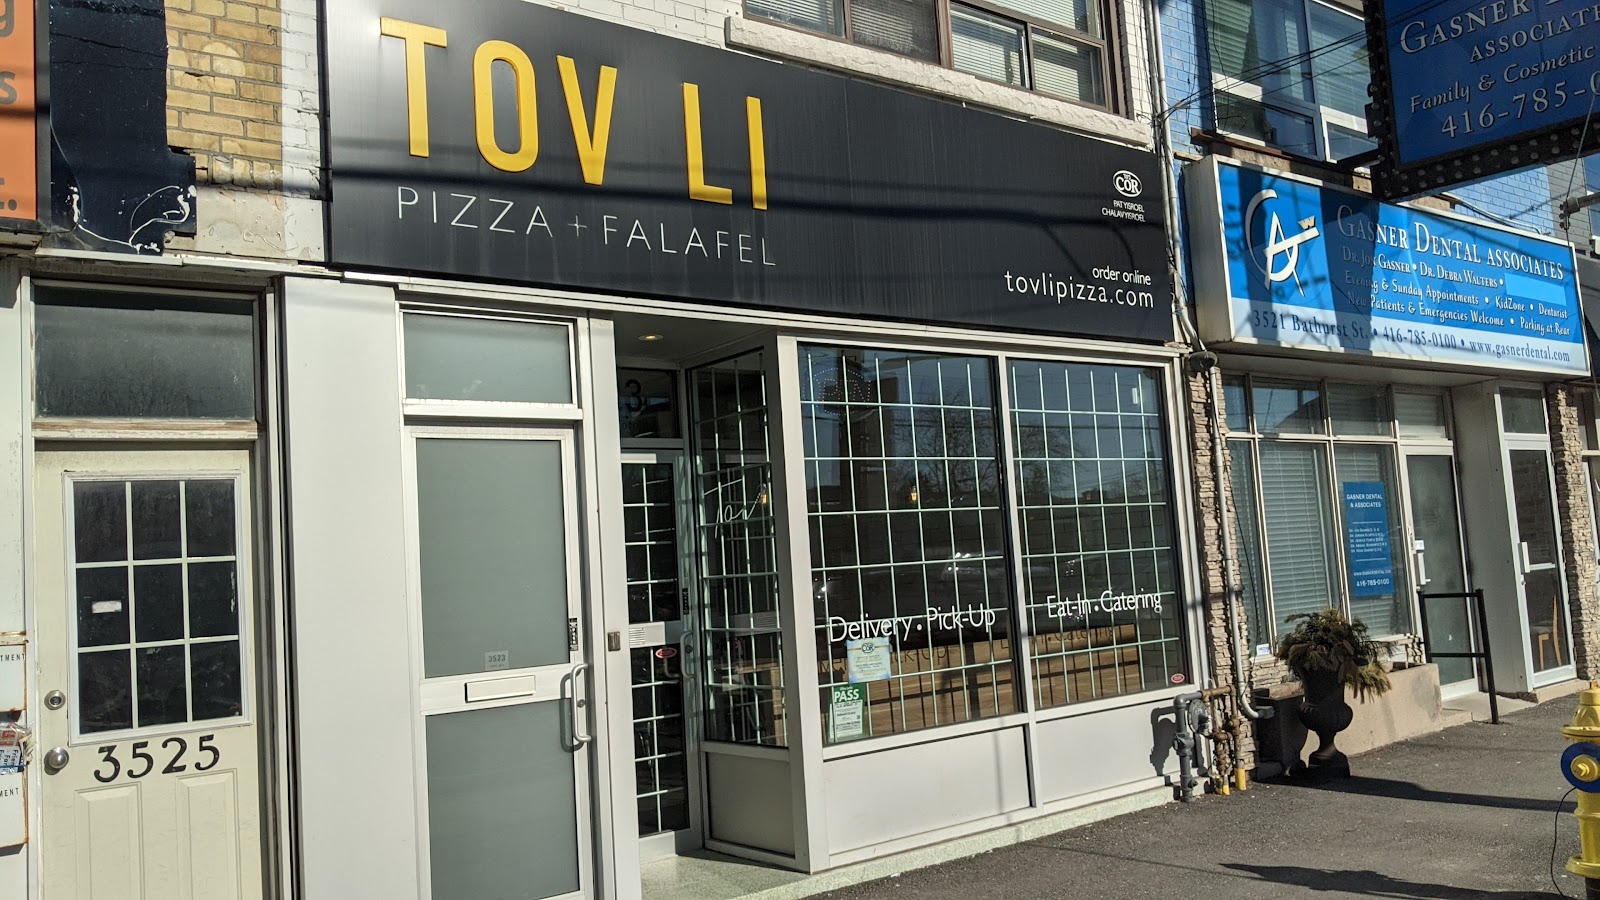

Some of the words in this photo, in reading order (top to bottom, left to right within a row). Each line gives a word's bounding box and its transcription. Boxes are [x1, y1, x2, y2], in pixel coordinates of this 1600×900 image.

[1400, 0, 1531, 54] GASNER
[1410, 80, 1471, 114] Family
[1478, 74, 1495, 91] &
[1503, 45, 1596, 84] Cosmetic
[380, 16, 618, 186] TOV
[682, 82, 768, 211] LI
[1115, 176, 1139, 194] COR
[397, 186, 553, 239] PIZZA
[603, 214, 777, 267] FALAFEL
[1337, 204, 1409, 250] GASNER
[1414, 221, 1481, 263] DENTAL
[1486, 247, 1564, 280] ASSOCIATES
[1004, 270, 1154, 309] tovlipizza.com
[1092, 265, 1121, 282] order
[1122, 271, 1152, 285] online
[1345, 270, 1379, 294] Evening
[1381, 278, 1389, 290] &
[1392, 279, 1423, 300] Sunday
[1426, 285, 1479, 305] Appointments
[1495, 295, 1526, 312] KidZone
[1538, 303, 1568, 319] Denturist
[1253, 309, 1285, 330] 3521
[1291, 313, 1347, 338] Bathurst
[1351, 321, 1369, 339] St.
[1383, 324, 1457, 349] 416-785-0100
[1469, 341, 1570, 362] www.gasnerdental.com
[1347, 291, 1367, 307] New
[1370, 294, 1405, 312] Patients
[1408, 302, 1416, 314] &
[1418, 302, 1468, 323] Emergencies
[1470, 310, 1505, 327] Welcome
[1520, 316, 1545, 336] Parking
[1546, 324, 1553, 333] at
[1555, 322, 1570, 336] Rear
[828, 613, 912, 643] Delivery
[926, 602, 996, 633] Pick-Up
[1046, 593, 1092, 619] Eat-In
[1100, 587, 1162, 614] Catering
[488, 654, 506, 663] 3523
[834, 688, 860, 702] PASS
[93, 733, 220, 783] 3525
